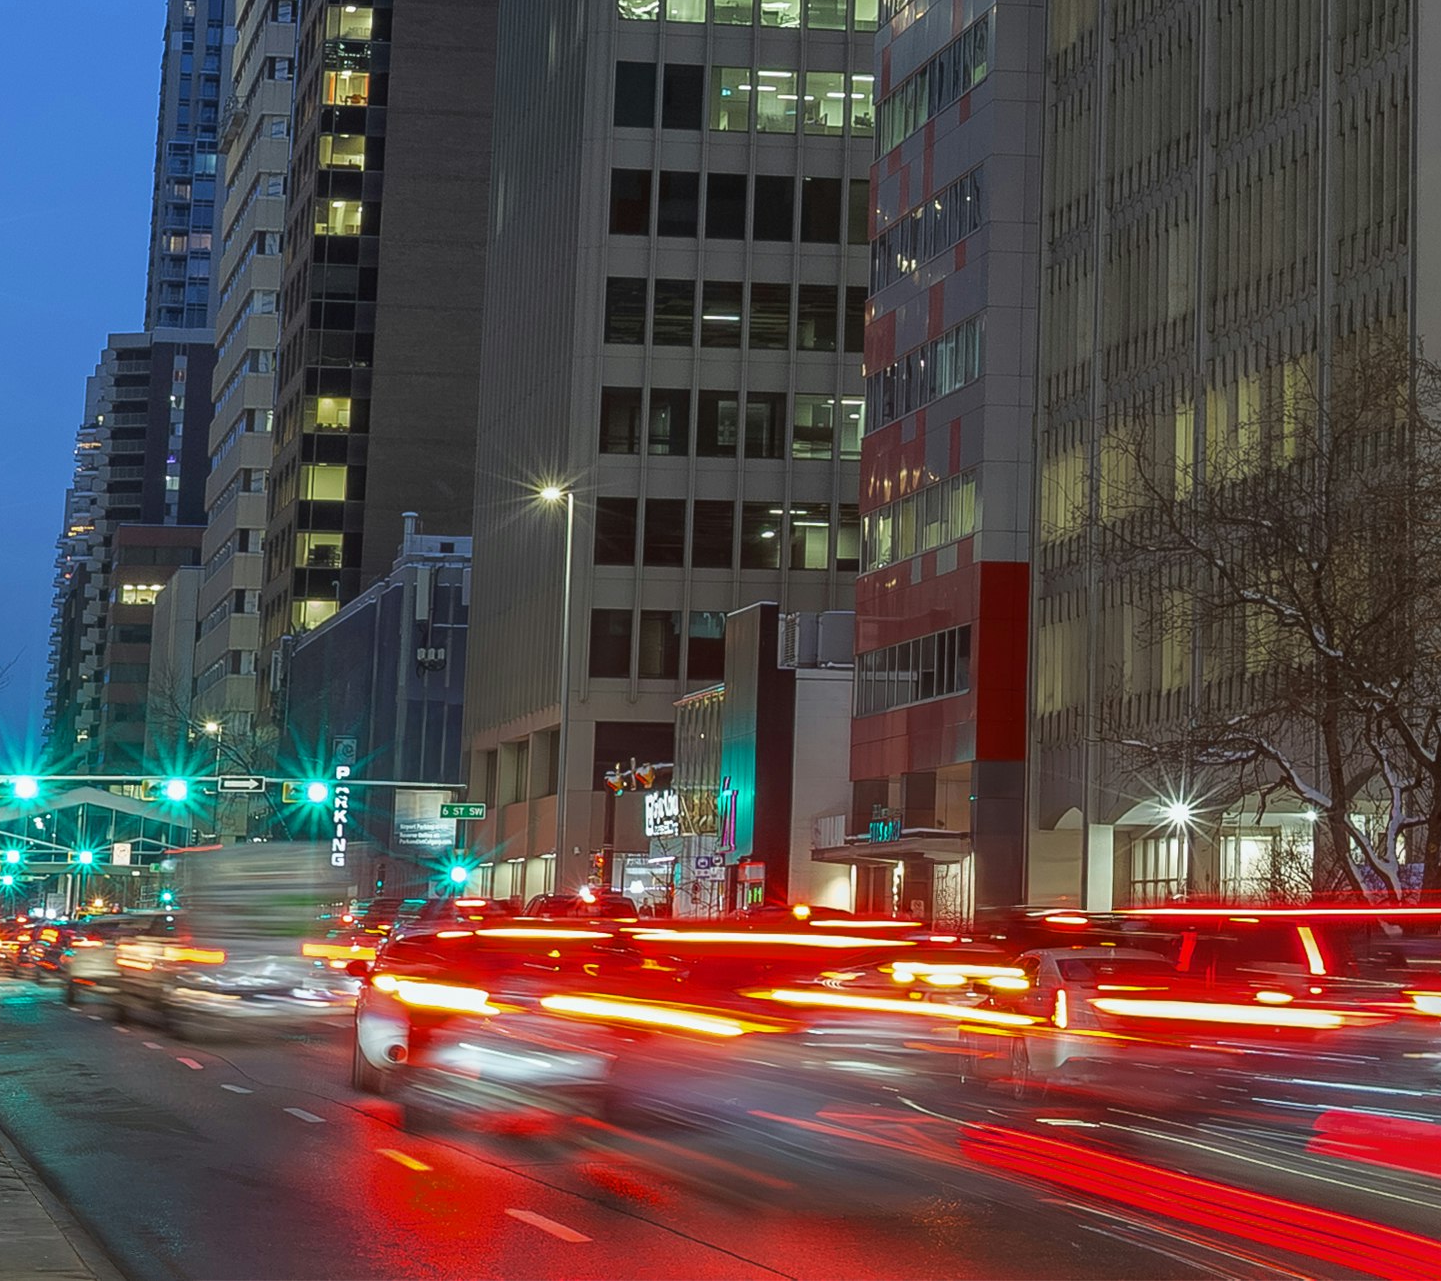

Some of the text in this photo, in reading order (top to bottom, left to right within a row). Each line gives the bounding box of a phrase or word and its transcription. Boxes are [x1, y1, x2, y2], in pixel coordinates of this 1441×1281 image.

[442, 807, 484, 816] 6 ST SW
